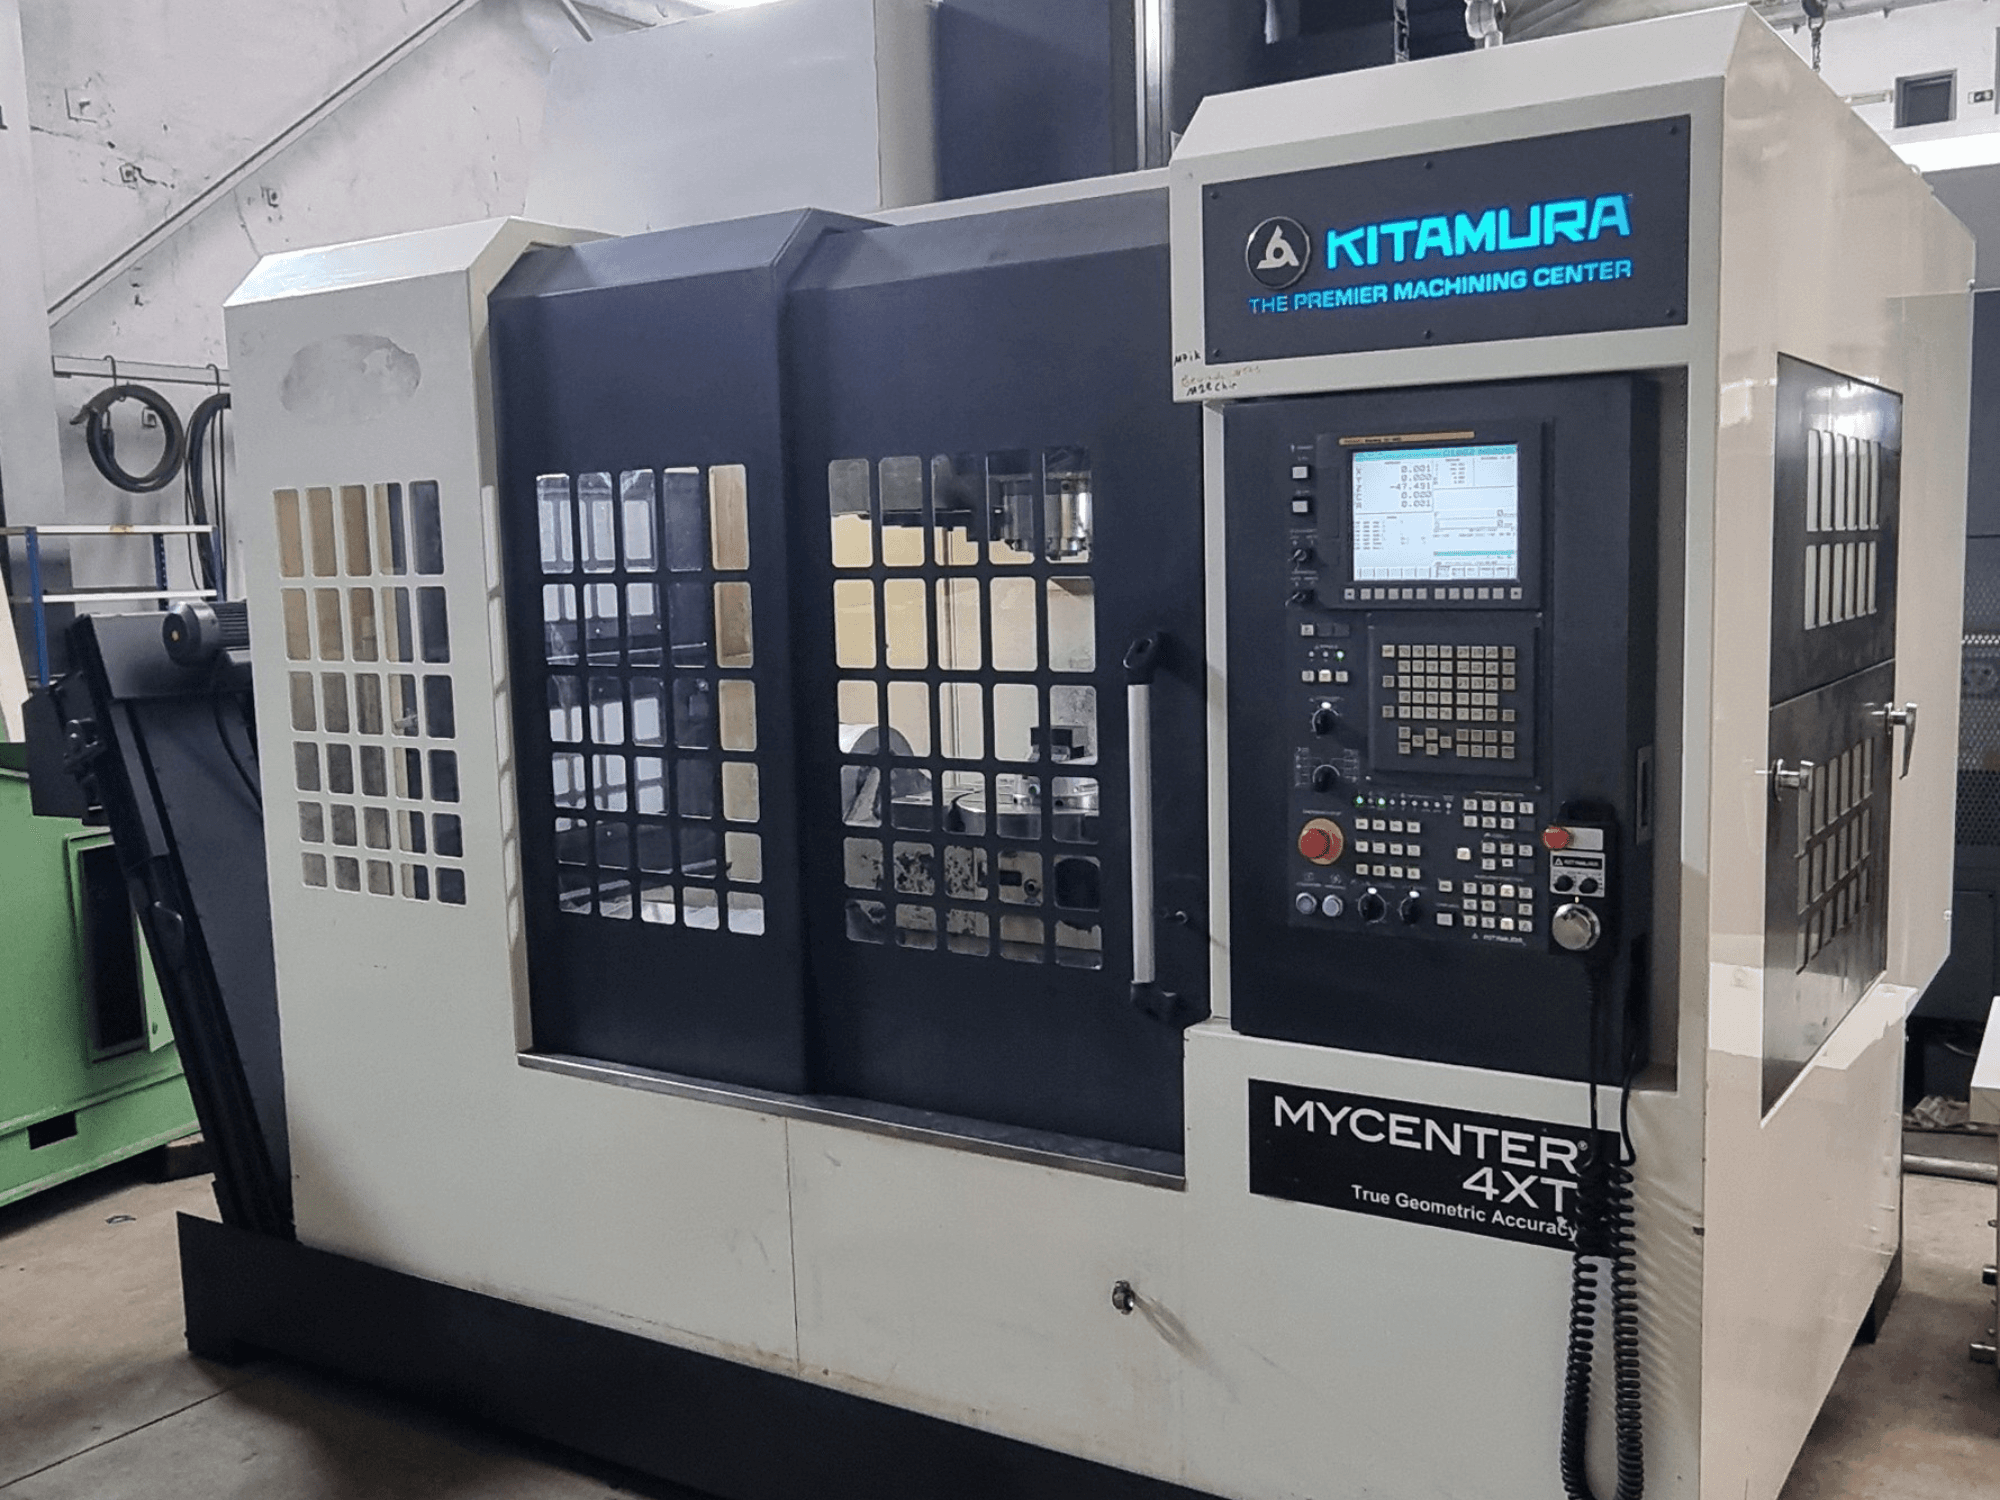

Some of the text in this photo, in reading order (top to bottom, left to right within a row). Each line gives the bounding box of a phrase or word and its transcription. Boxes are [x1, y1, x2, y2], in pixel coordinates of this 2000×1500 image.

[1327, 195, 1630, 270] KITAMURA
[1249, 260, 1632, 313] THE PREMIER MACHINING CENTER
[1351, 1184, 1578, 1242] True Geometric Accuracy
